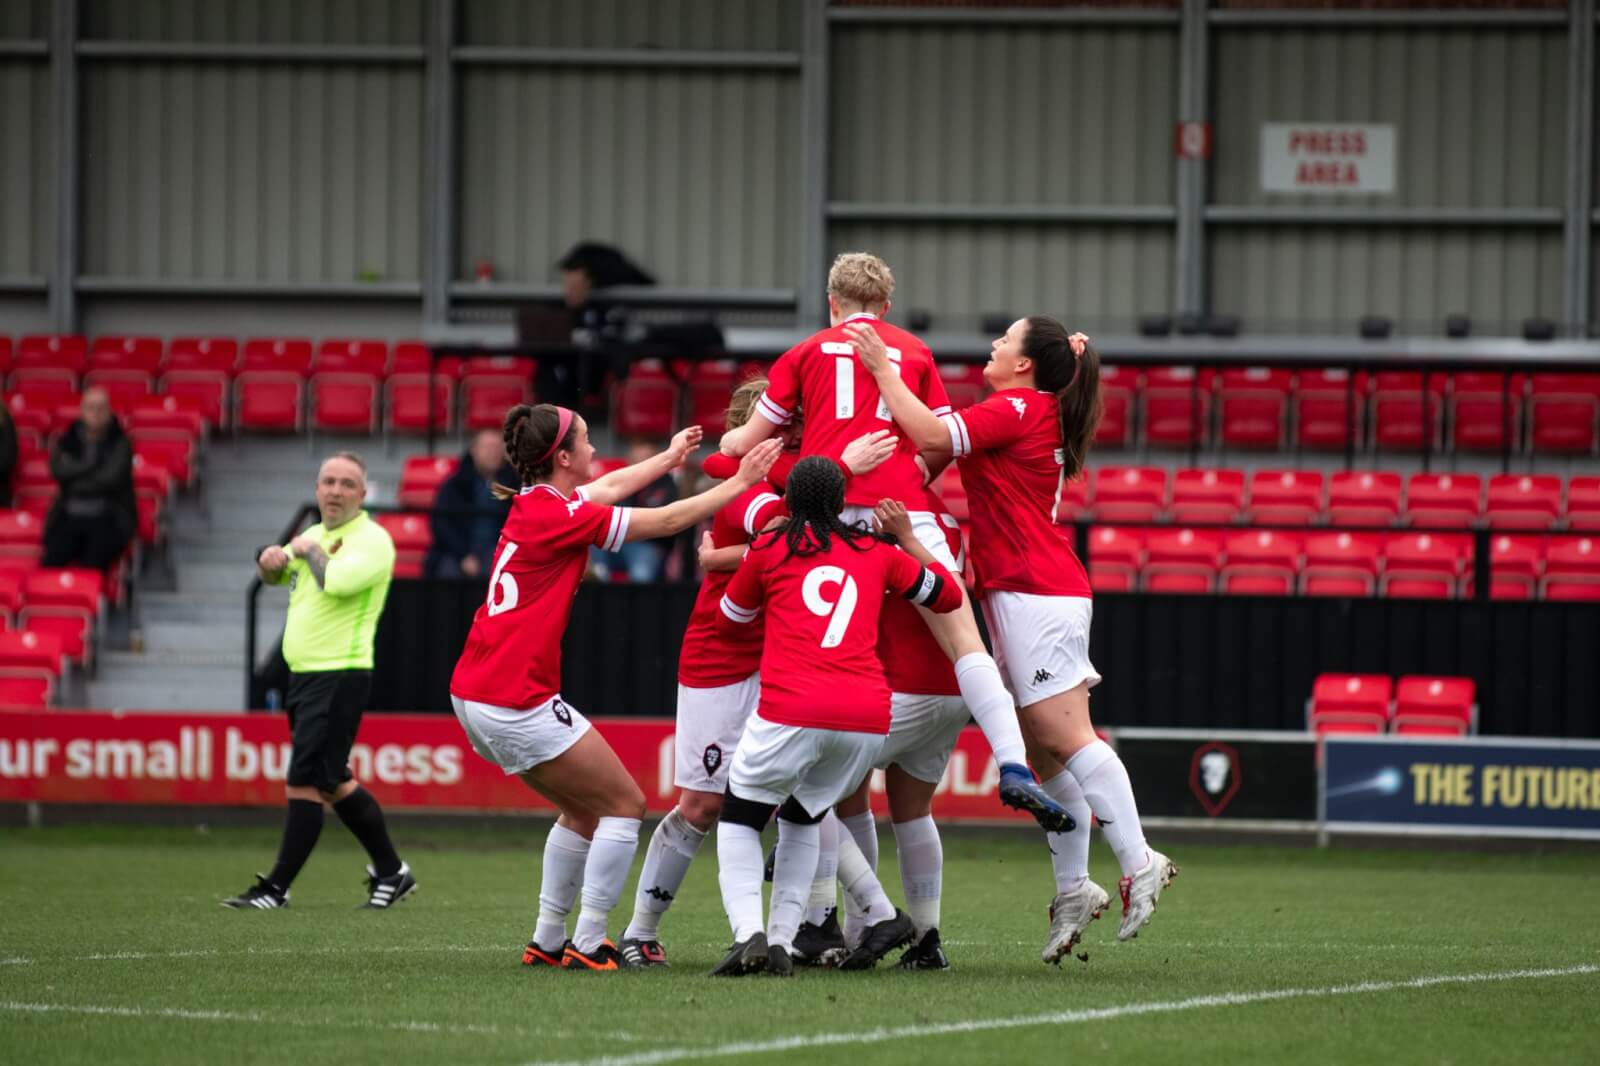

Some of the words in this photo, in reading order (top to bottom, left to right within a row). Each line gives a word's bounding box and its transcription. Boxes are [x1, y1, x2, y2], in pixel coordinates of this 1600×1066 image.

[1289, 130, 1366, 155] PRESS
[1296, 162, 1360, 185] AREA
[487, 541, 518, 616] 6
[802, 565, 858, 648] 9
[66, 726, 213, 779] small
[226, 727, 463, 783] buness
[1410, 764, 1474, 805] THE
